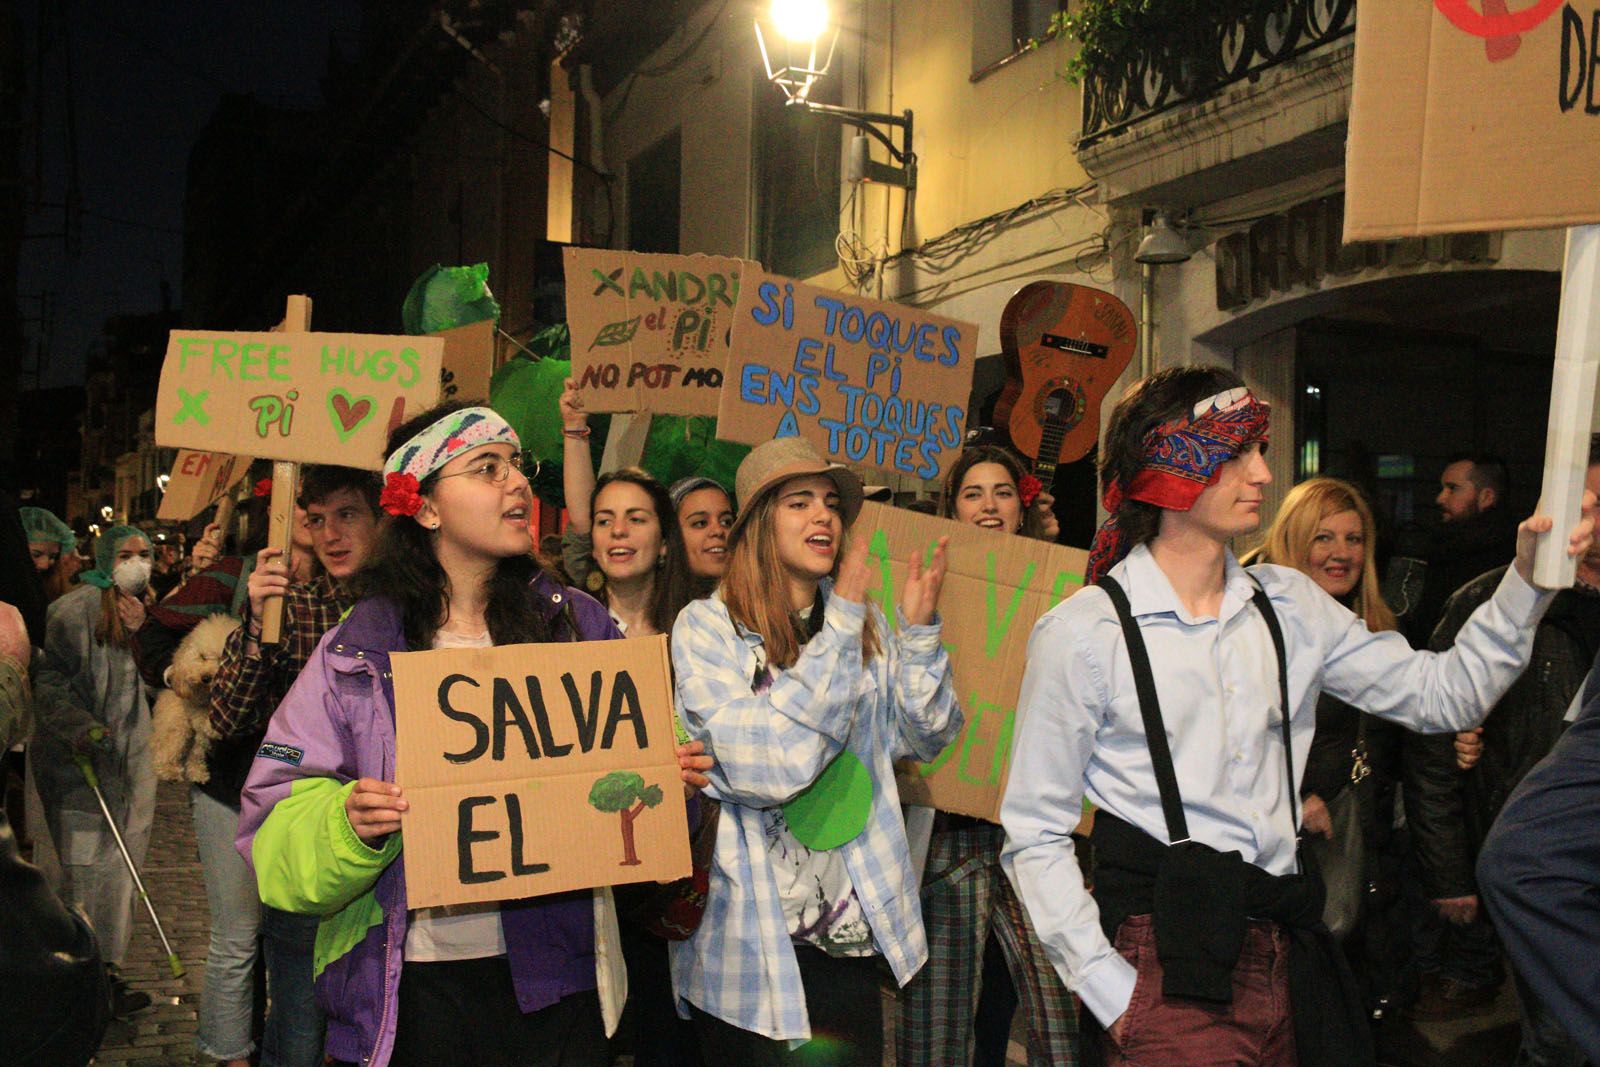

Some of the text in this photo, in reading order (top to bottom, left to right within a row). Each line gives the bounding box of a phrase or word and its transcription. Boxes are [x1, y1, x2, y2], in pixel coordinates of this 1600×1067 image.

[673, 306, 713, 351] Pi
[815, 296, 961, 367] TOQUES
[176, 338, 293, 381] FREE
[320, 345, 421, 389] HUGS
[580, 363, 621, 389] NO
[627, 362, 681, 388] POT
[794, 338, 848, 381] EL
[250, 389, 299, 438] Pi
[740, 364, 964, 448] ENS TOQUES
[818, 418, 942, 480] TOTES
[437, 670, 649, 764] SALVA
[457, 793, 551, 885] EL
